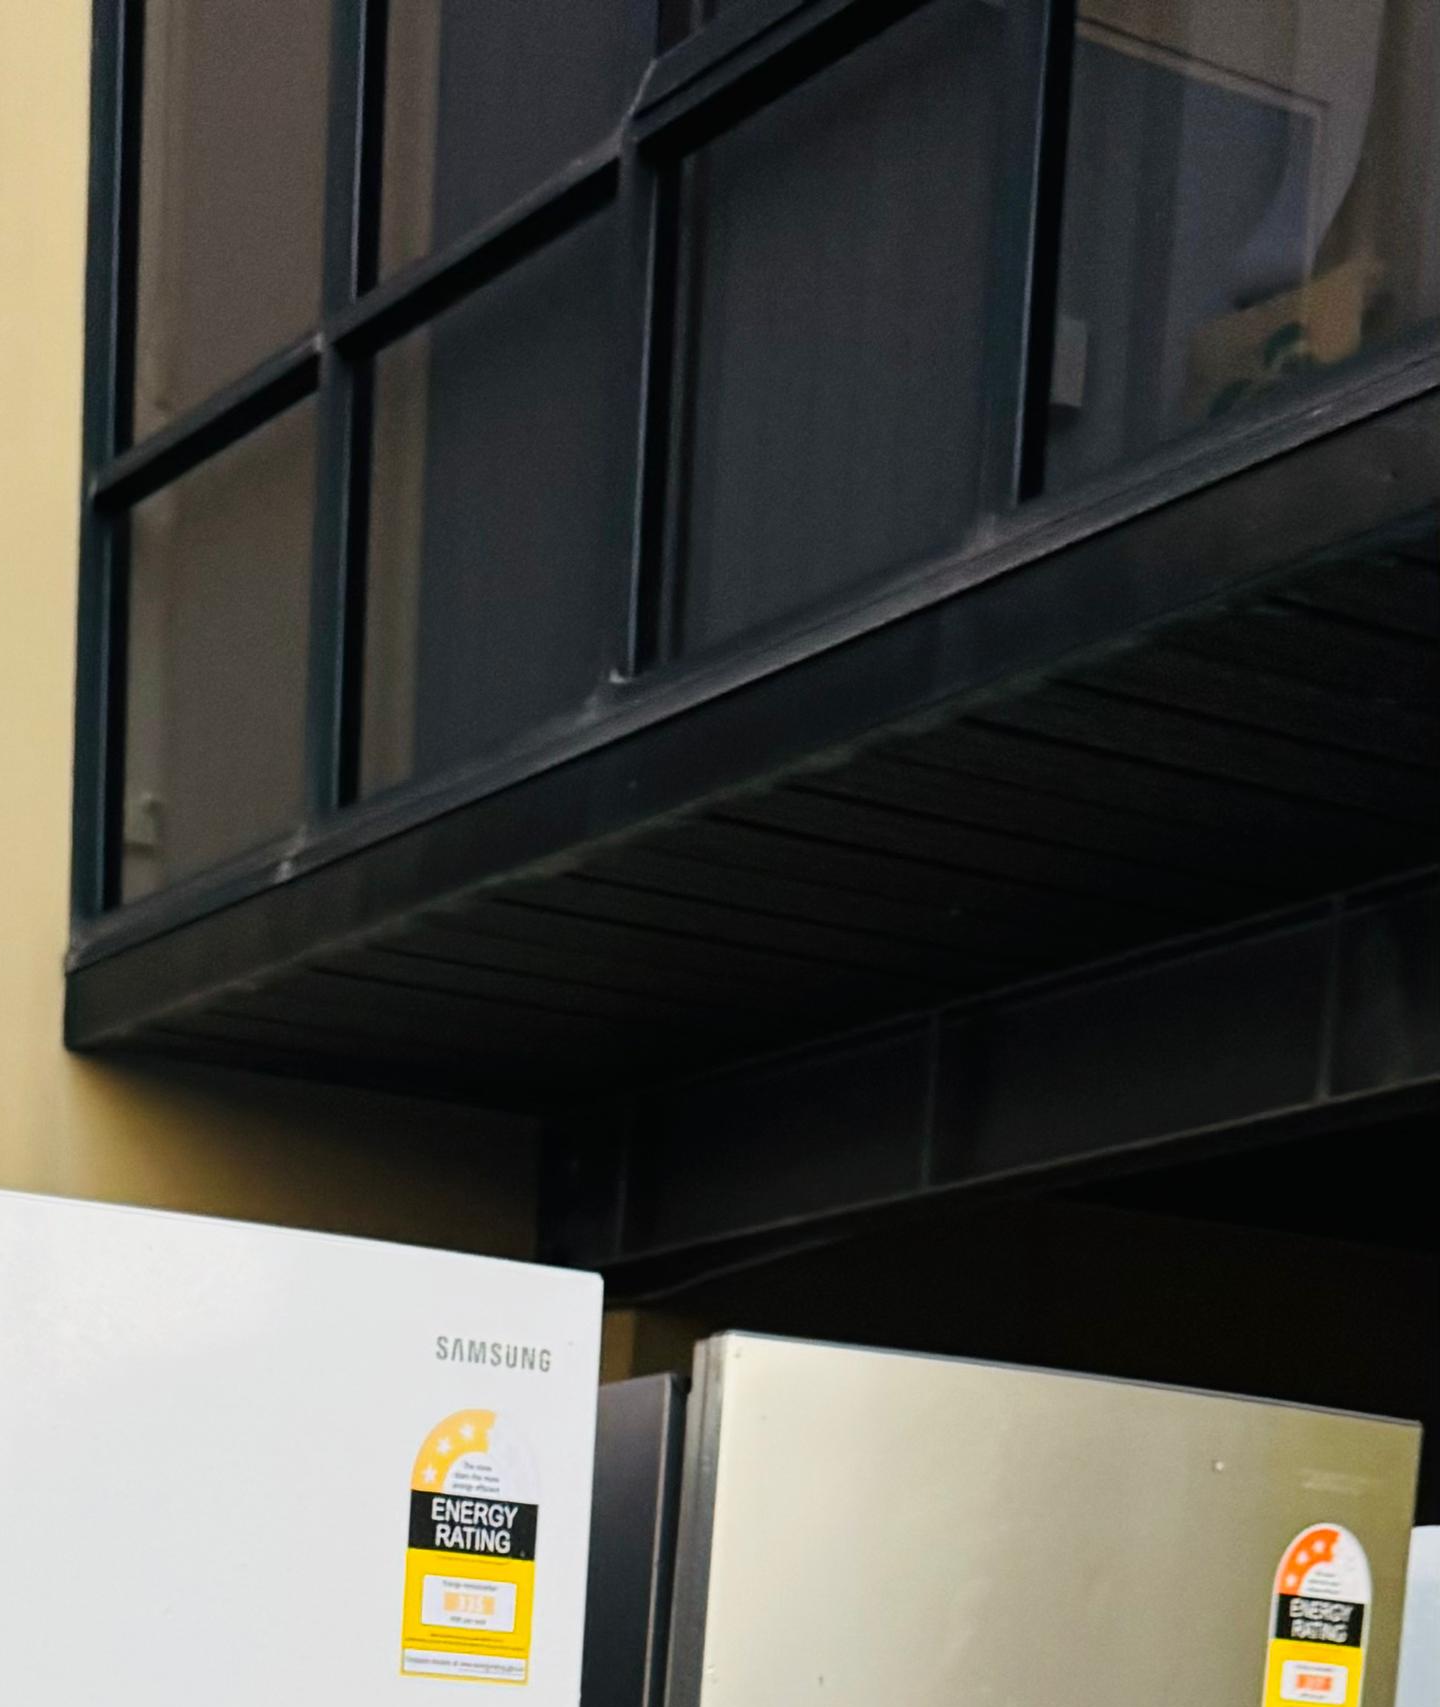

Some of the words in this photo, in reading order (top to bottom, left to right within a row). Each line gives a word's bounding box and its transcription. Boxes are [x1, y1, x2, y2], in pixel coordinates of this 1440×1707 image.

[436, 1335, 551, 1373] SAMSUNG
[431, 1497, 519, 1529] ENERGY
[435, 1523, 511, 1554] RATING
